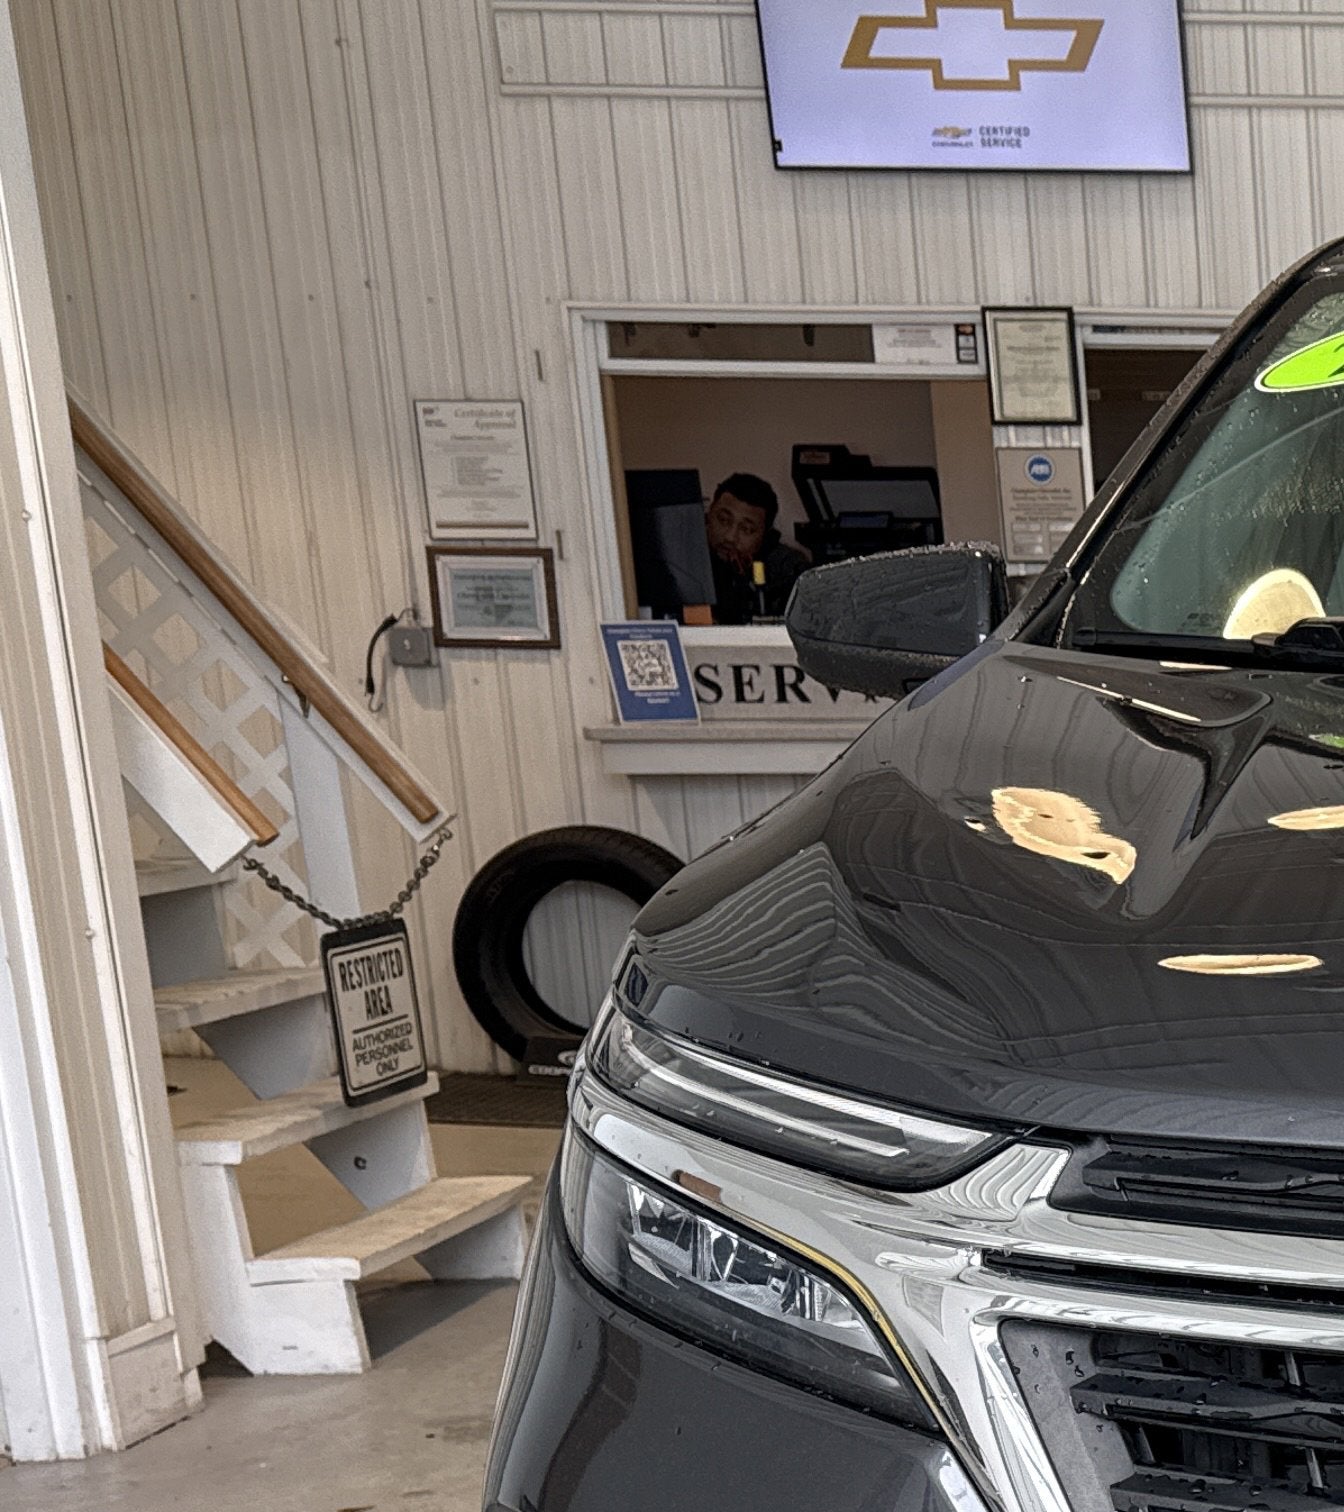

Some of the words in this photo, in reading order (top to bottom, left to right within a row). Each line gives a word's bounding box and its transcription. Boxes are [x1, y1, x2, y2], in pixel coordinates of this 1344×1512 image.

[338, 948, 404, 992] RESTRICTED
[364, 985, 393, 1021] AREA
[352, 1021, 413, 1052] AUTHORIZED
[355, 1037, 414, 1068] PERSONNEL
[375, 1056, 401, 1077] ONLY
